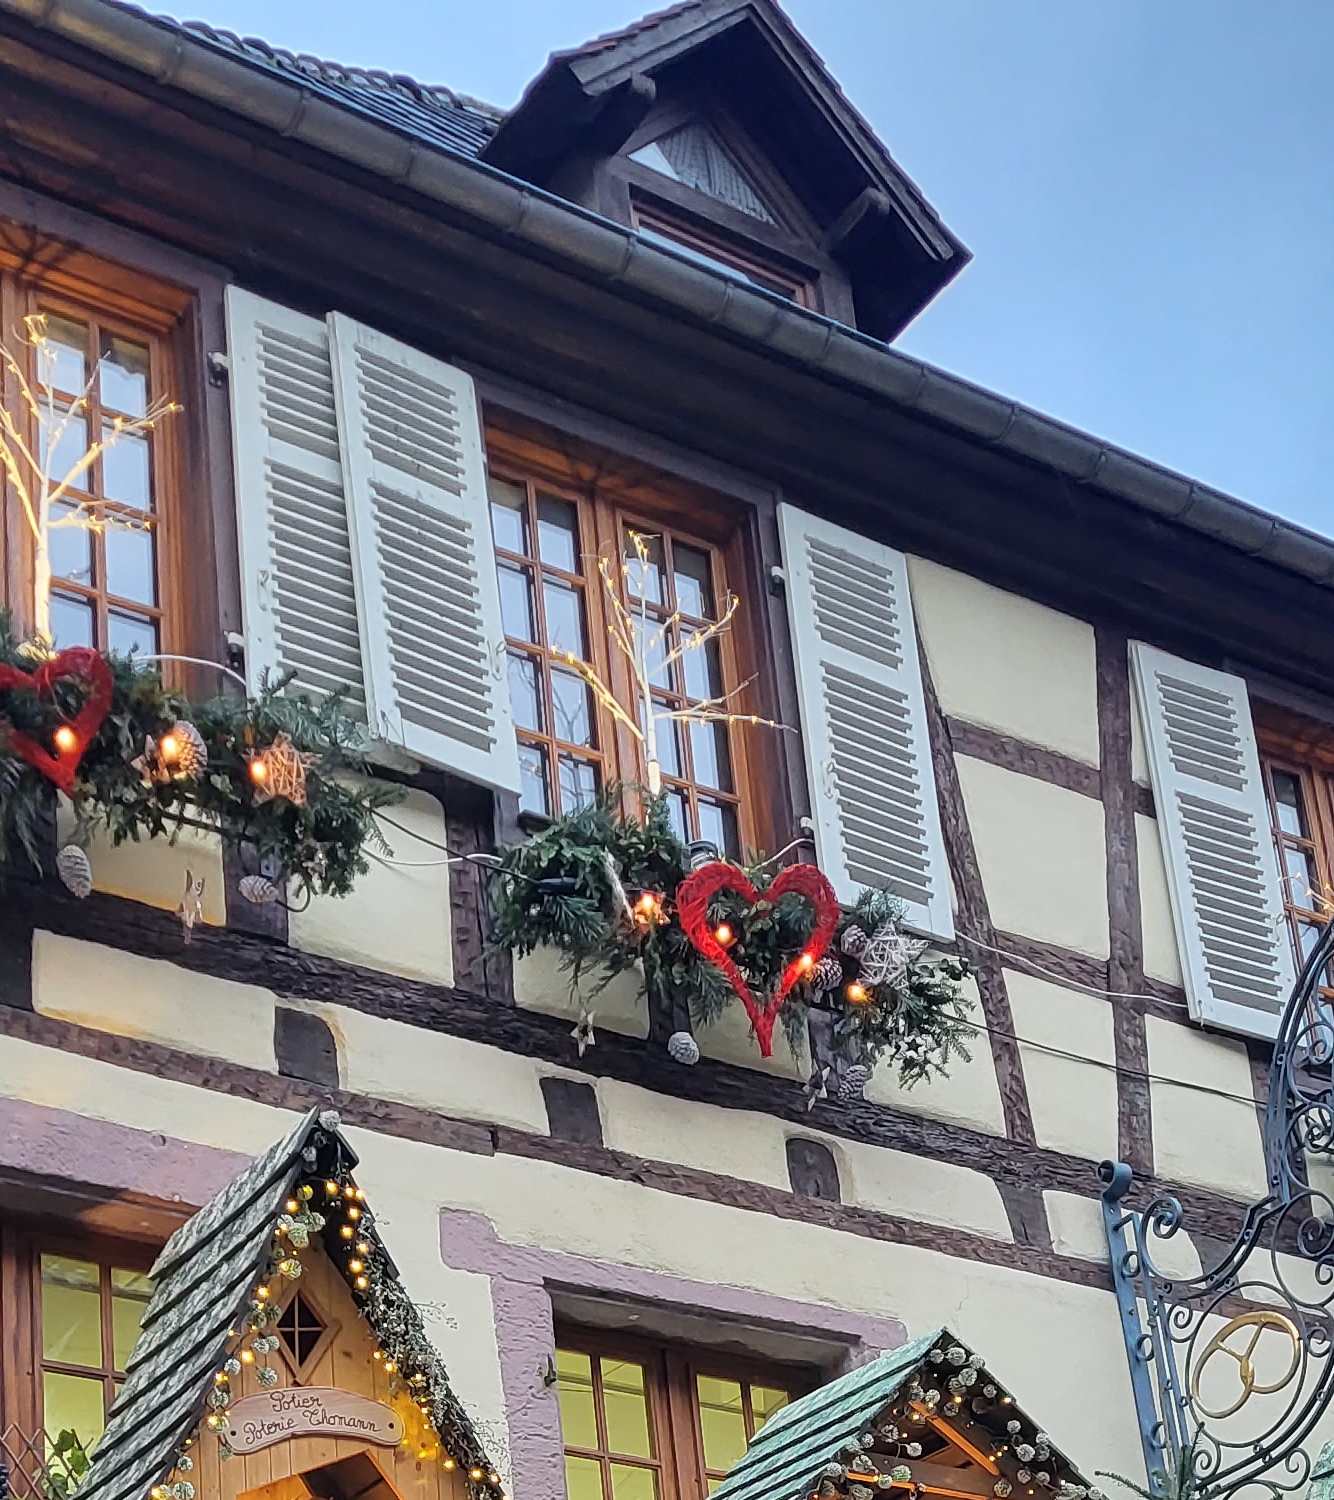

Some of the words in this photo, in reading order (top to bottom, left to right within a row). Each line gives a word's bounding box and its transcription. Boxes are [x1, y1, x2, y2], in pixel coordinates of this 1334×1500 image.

[269, 1391, 323, 1413] Potier
[243, 1416, 298, 1445] Poterie
[302, 1409, 381, 1433] Thomann
